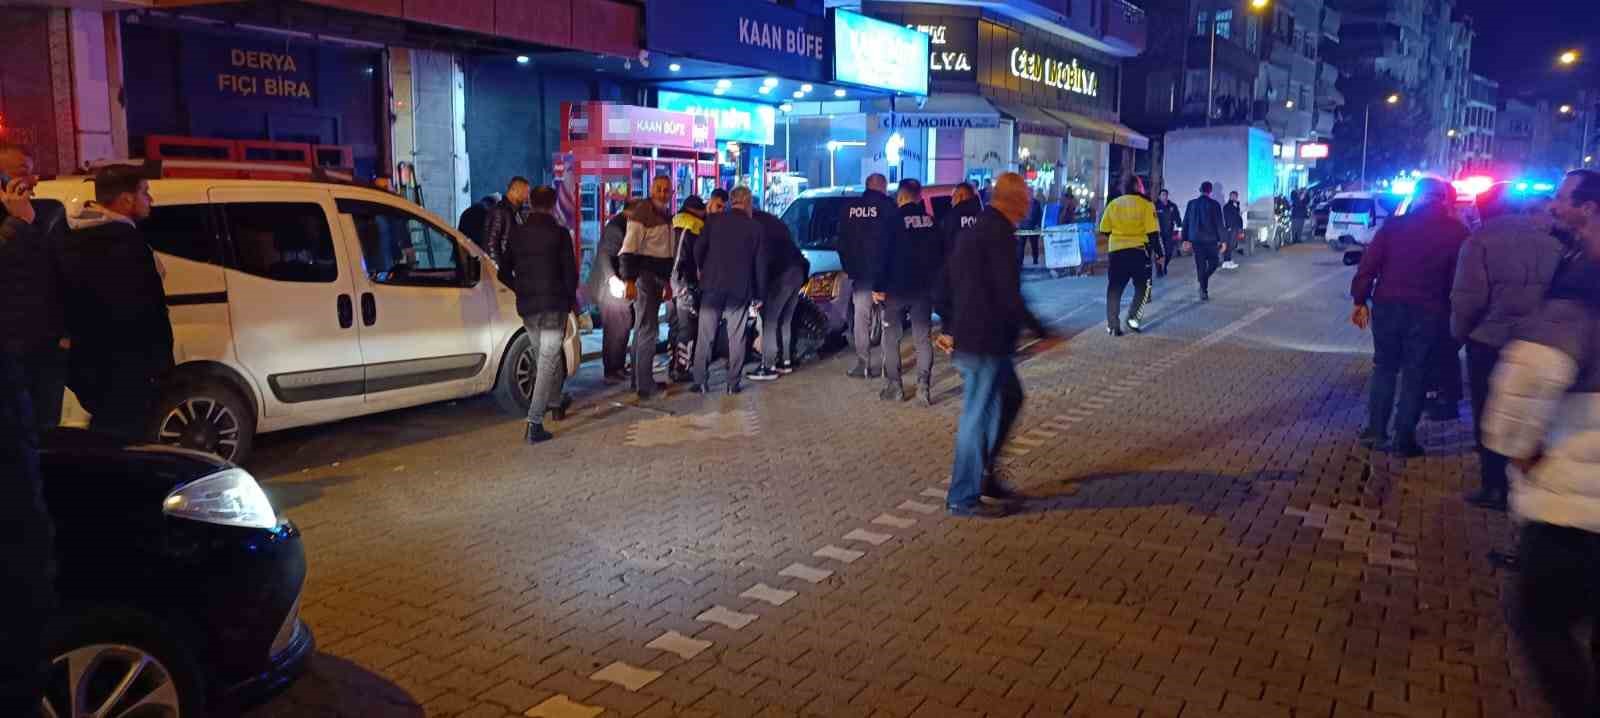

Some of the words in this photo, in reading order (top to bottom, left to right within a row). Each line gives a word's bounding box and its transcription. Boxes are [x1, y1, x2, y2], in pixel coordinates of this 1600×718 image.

[739, 17, 782, 52] KAAN
[786, 27, 823, 60] BÜFE
[231, 48, 297, 73] DERYA
[1011, 47, 1042, 82] CEM
[218, 73, 257, 96] FIÇI
[264, 76, 311, 99] BİRA
[636, 119, 662, 133] KAAN
